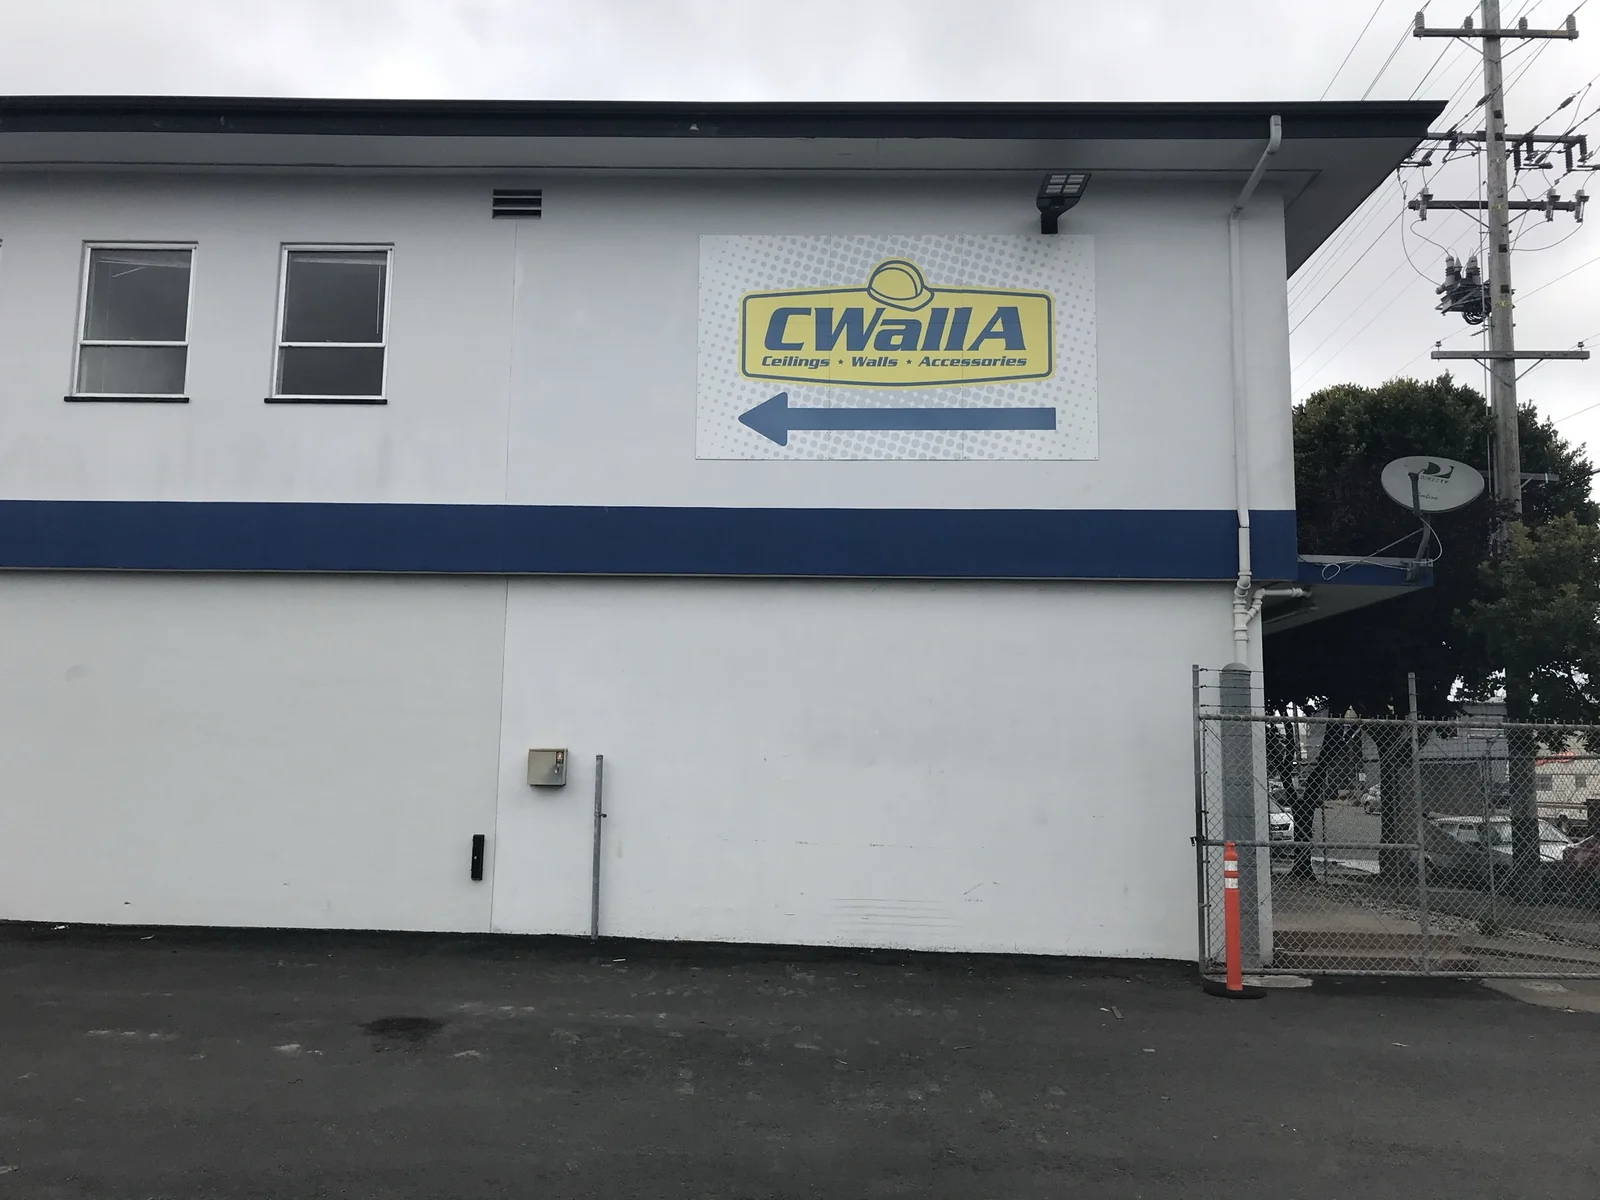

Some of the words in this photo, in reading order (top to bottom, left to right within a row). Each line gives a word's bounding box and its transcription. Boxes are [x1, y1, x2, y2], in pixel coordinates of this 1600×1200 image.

[764, 306, 1027, 351] CWallA
[761, 356, 830, 370] Ceilings
[851, 356, 898, 367] Walls
[918, 356, 1028, 367] Accessories
